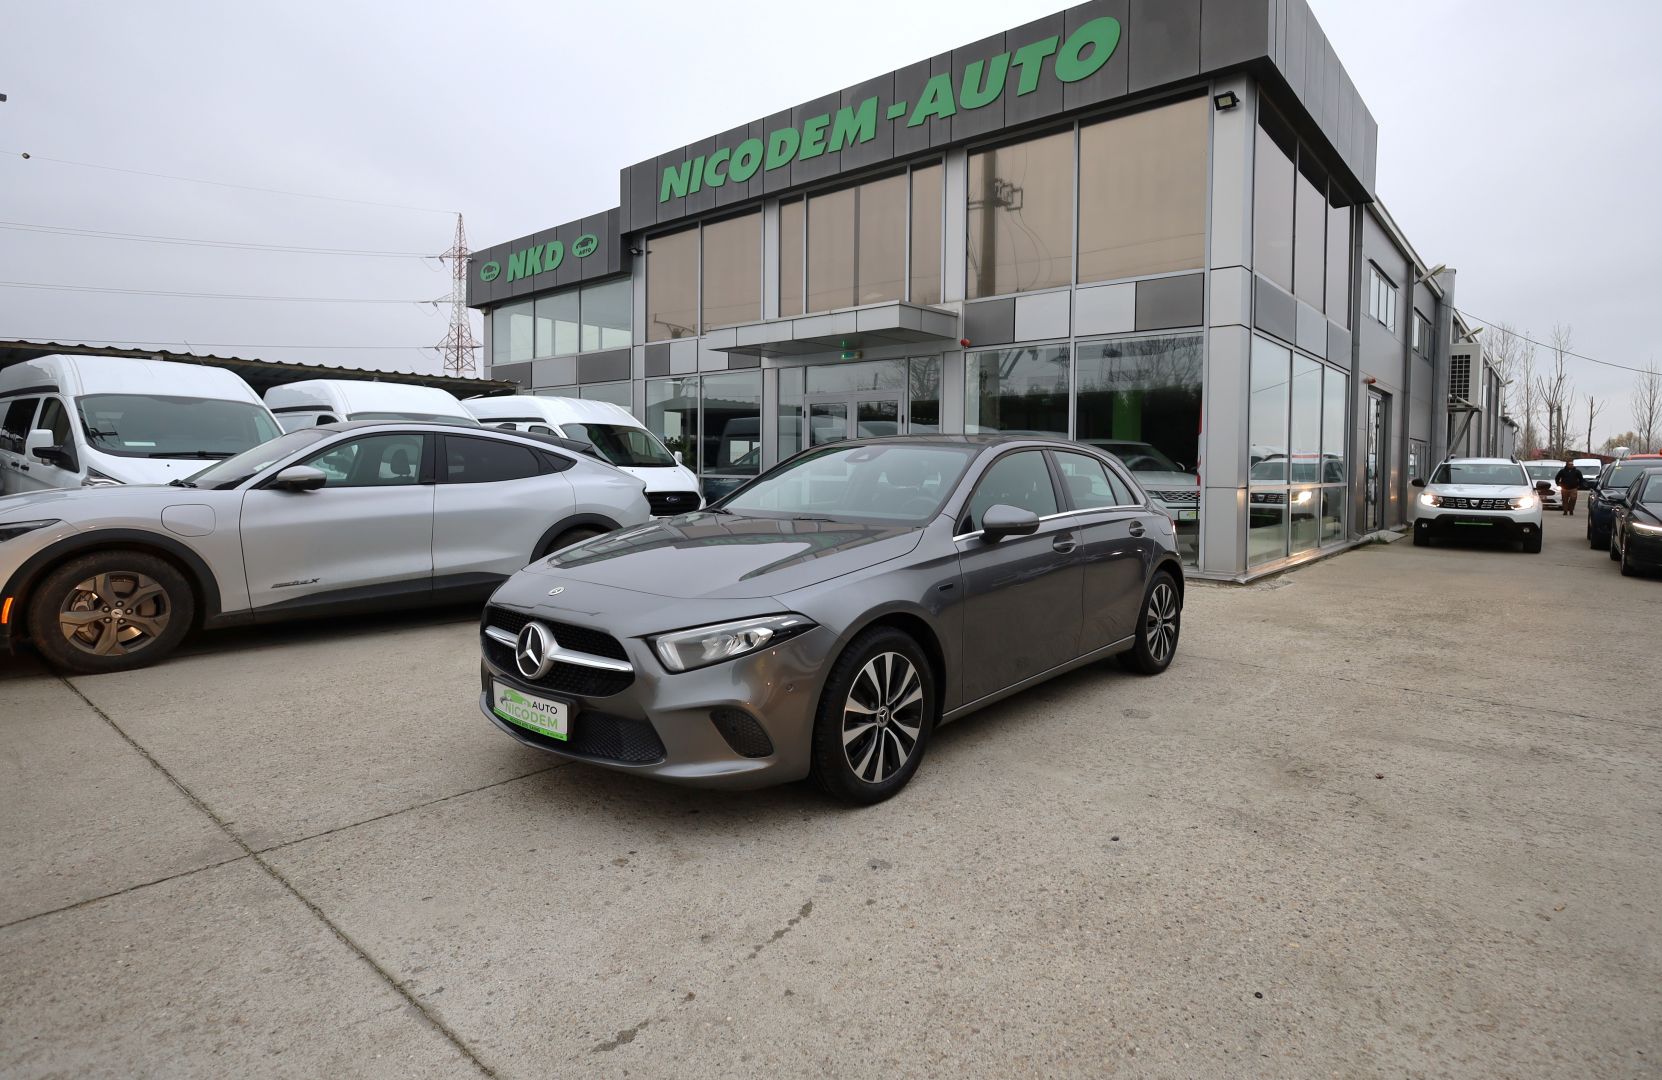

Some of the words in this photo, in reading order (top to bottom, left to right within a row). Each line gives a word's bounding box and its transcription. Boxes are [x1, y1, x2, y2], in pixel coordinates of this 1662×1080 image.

[506, 240, 565, 283] NKD
[505, 702, 558, 730] NICODEM
[532, 701, 558, 715] AUTO
